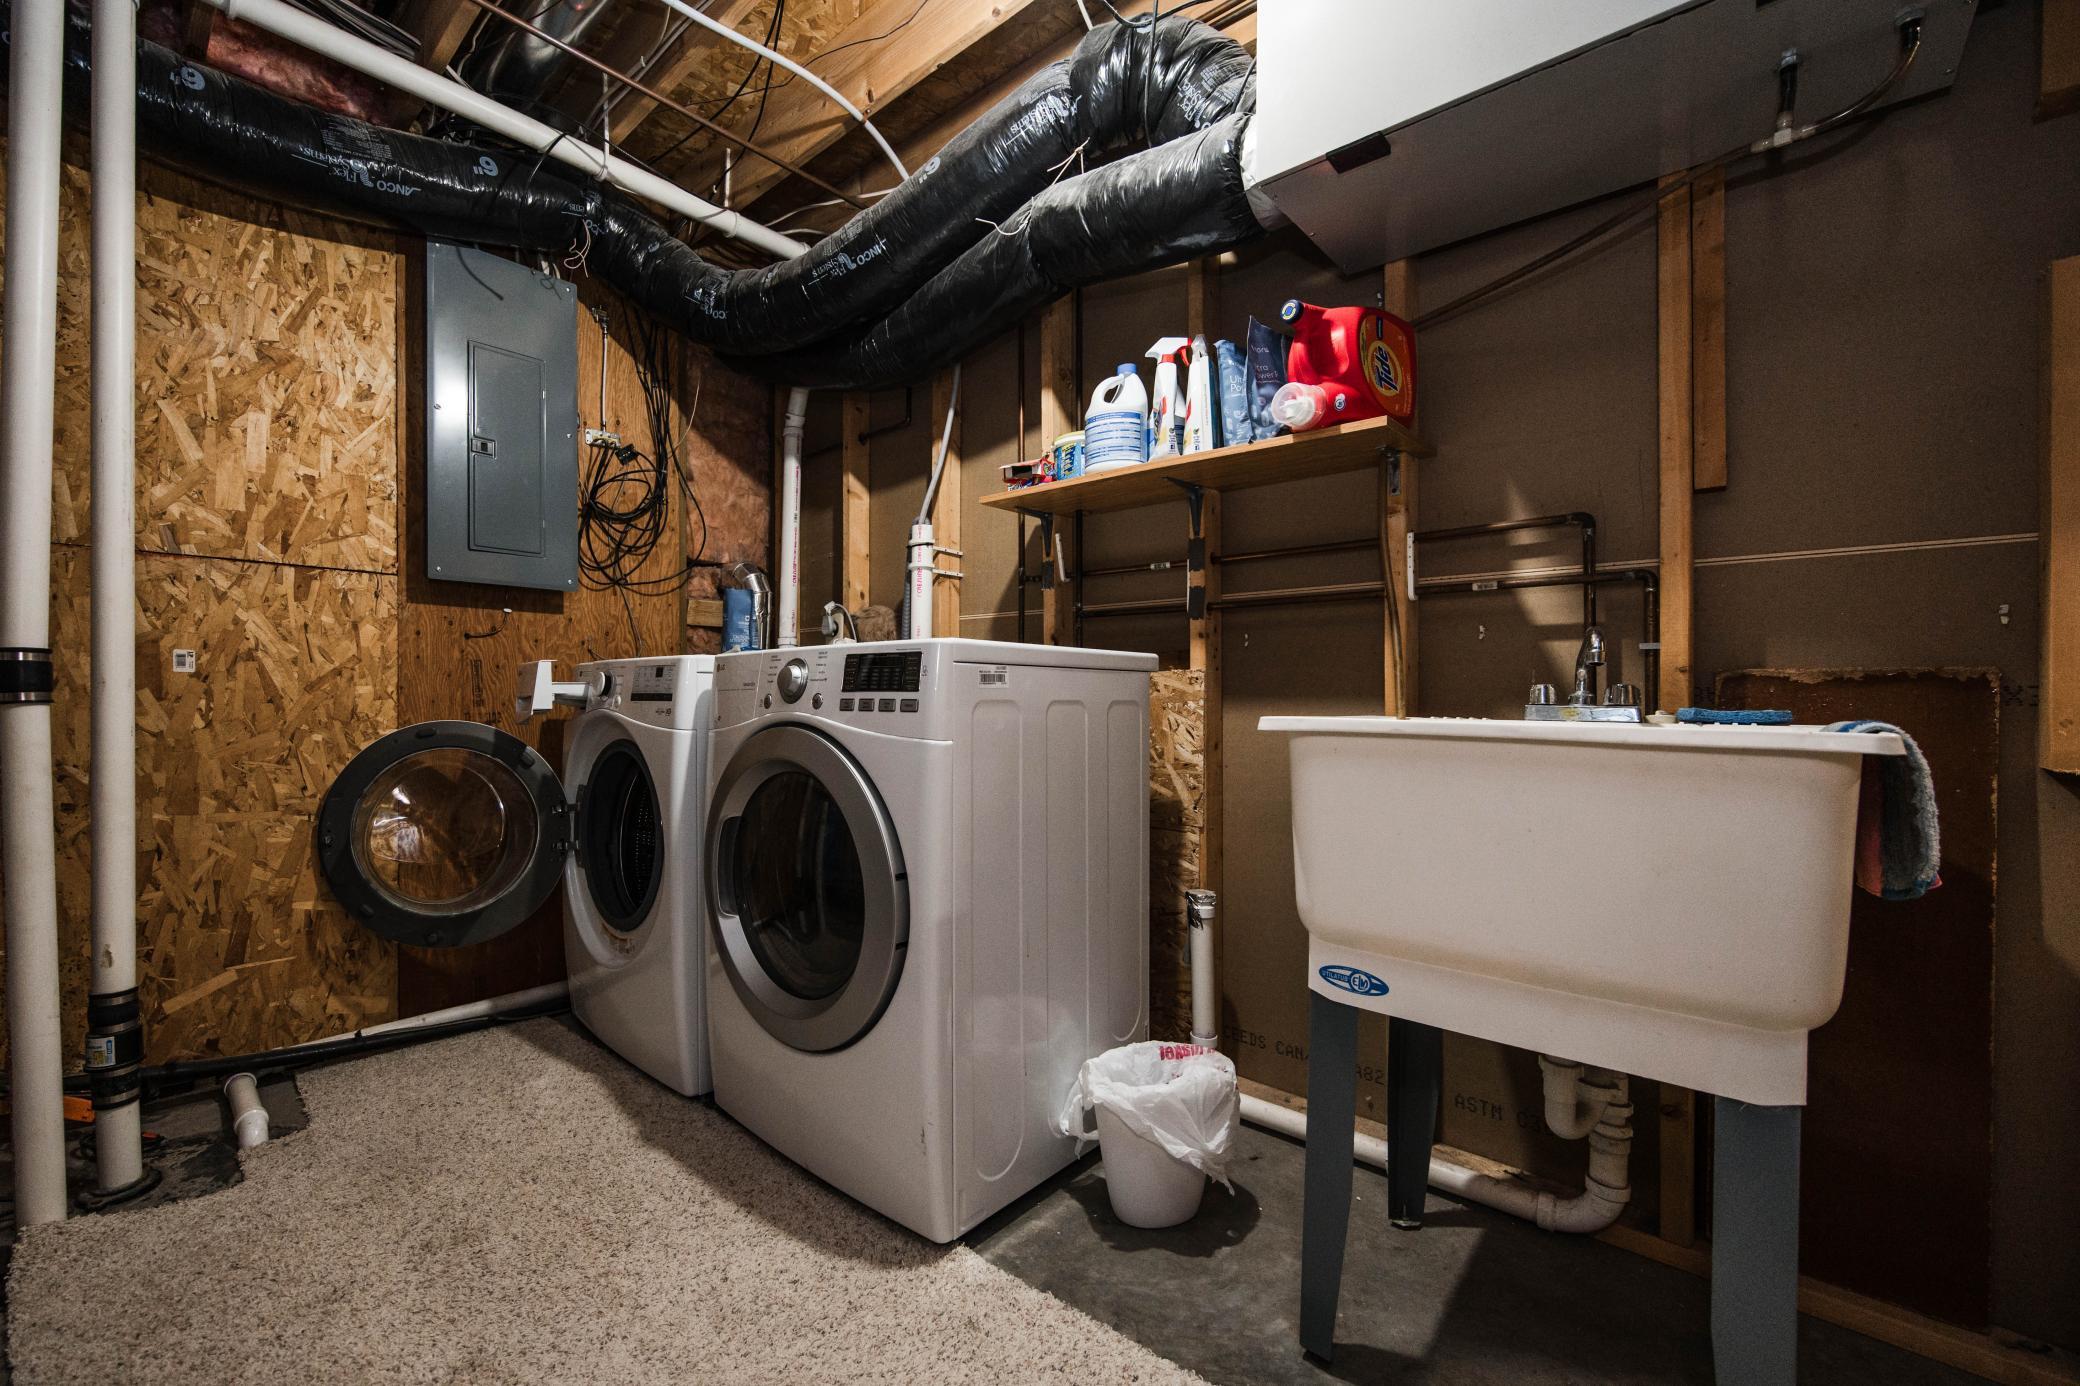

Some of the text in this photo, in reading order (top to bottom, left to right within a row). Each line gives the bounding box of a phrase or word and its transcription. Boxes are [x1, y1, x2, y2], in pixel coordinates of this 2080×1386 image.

[472, 156, 499, 177] 6"
[1373, 345, 1401, 392] Tide
[1454, 1092, 1504, 1121] ASTM
